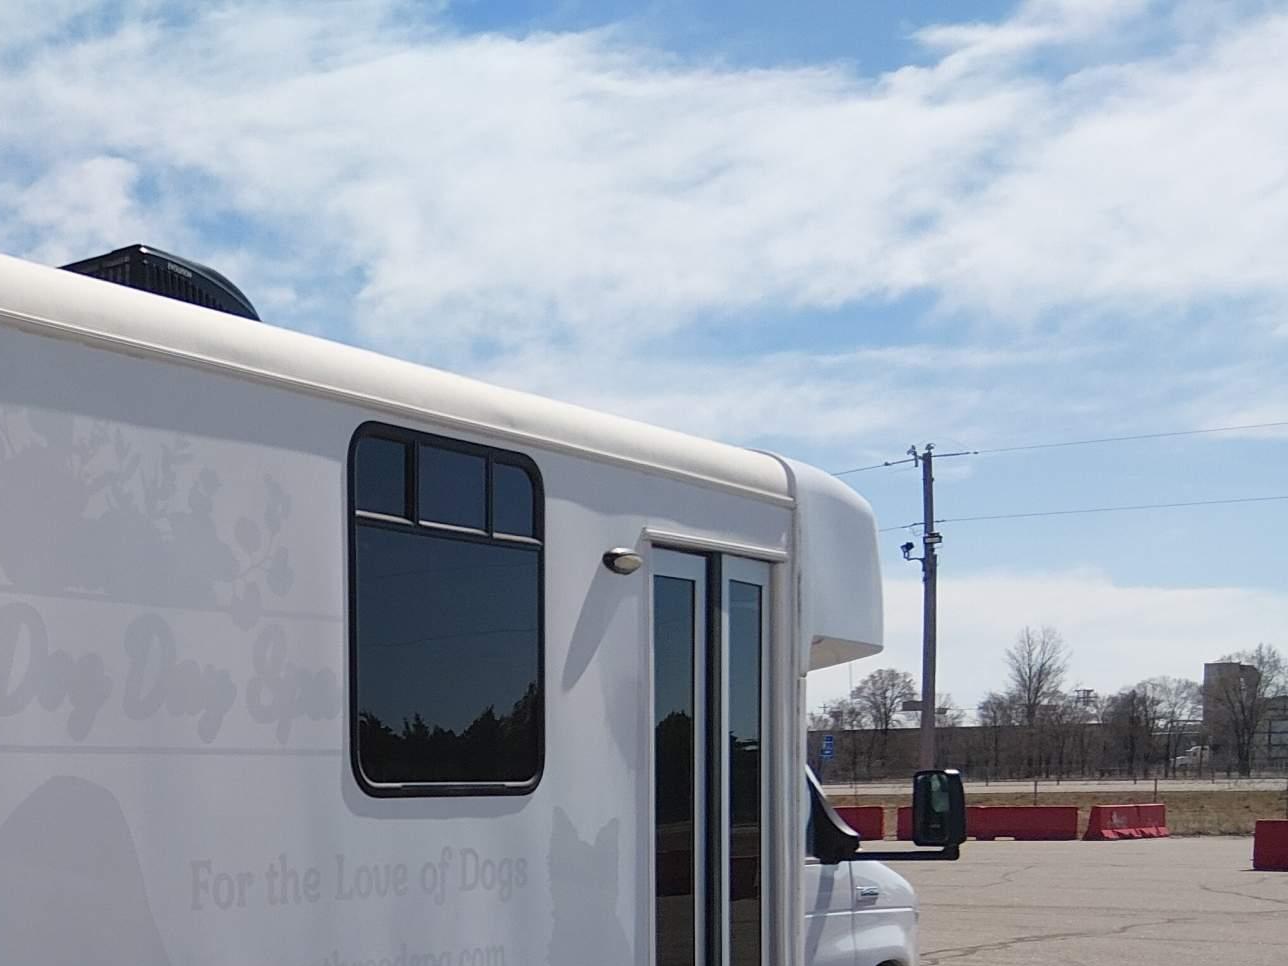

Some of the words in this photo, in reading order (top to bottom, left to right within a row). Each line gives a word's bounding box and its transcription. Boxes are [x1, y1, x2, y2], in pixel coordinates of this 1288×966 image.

[122, 613, 237, 744] Day
[246, 623, 343, 745] Spa
[190, 859, 254, 911] For
[265, 853, 321, 905] the
[334, 853, 409, 901] Love
[420, 845, 453, 906] of
[459, 847, 528, 902] Dogs
